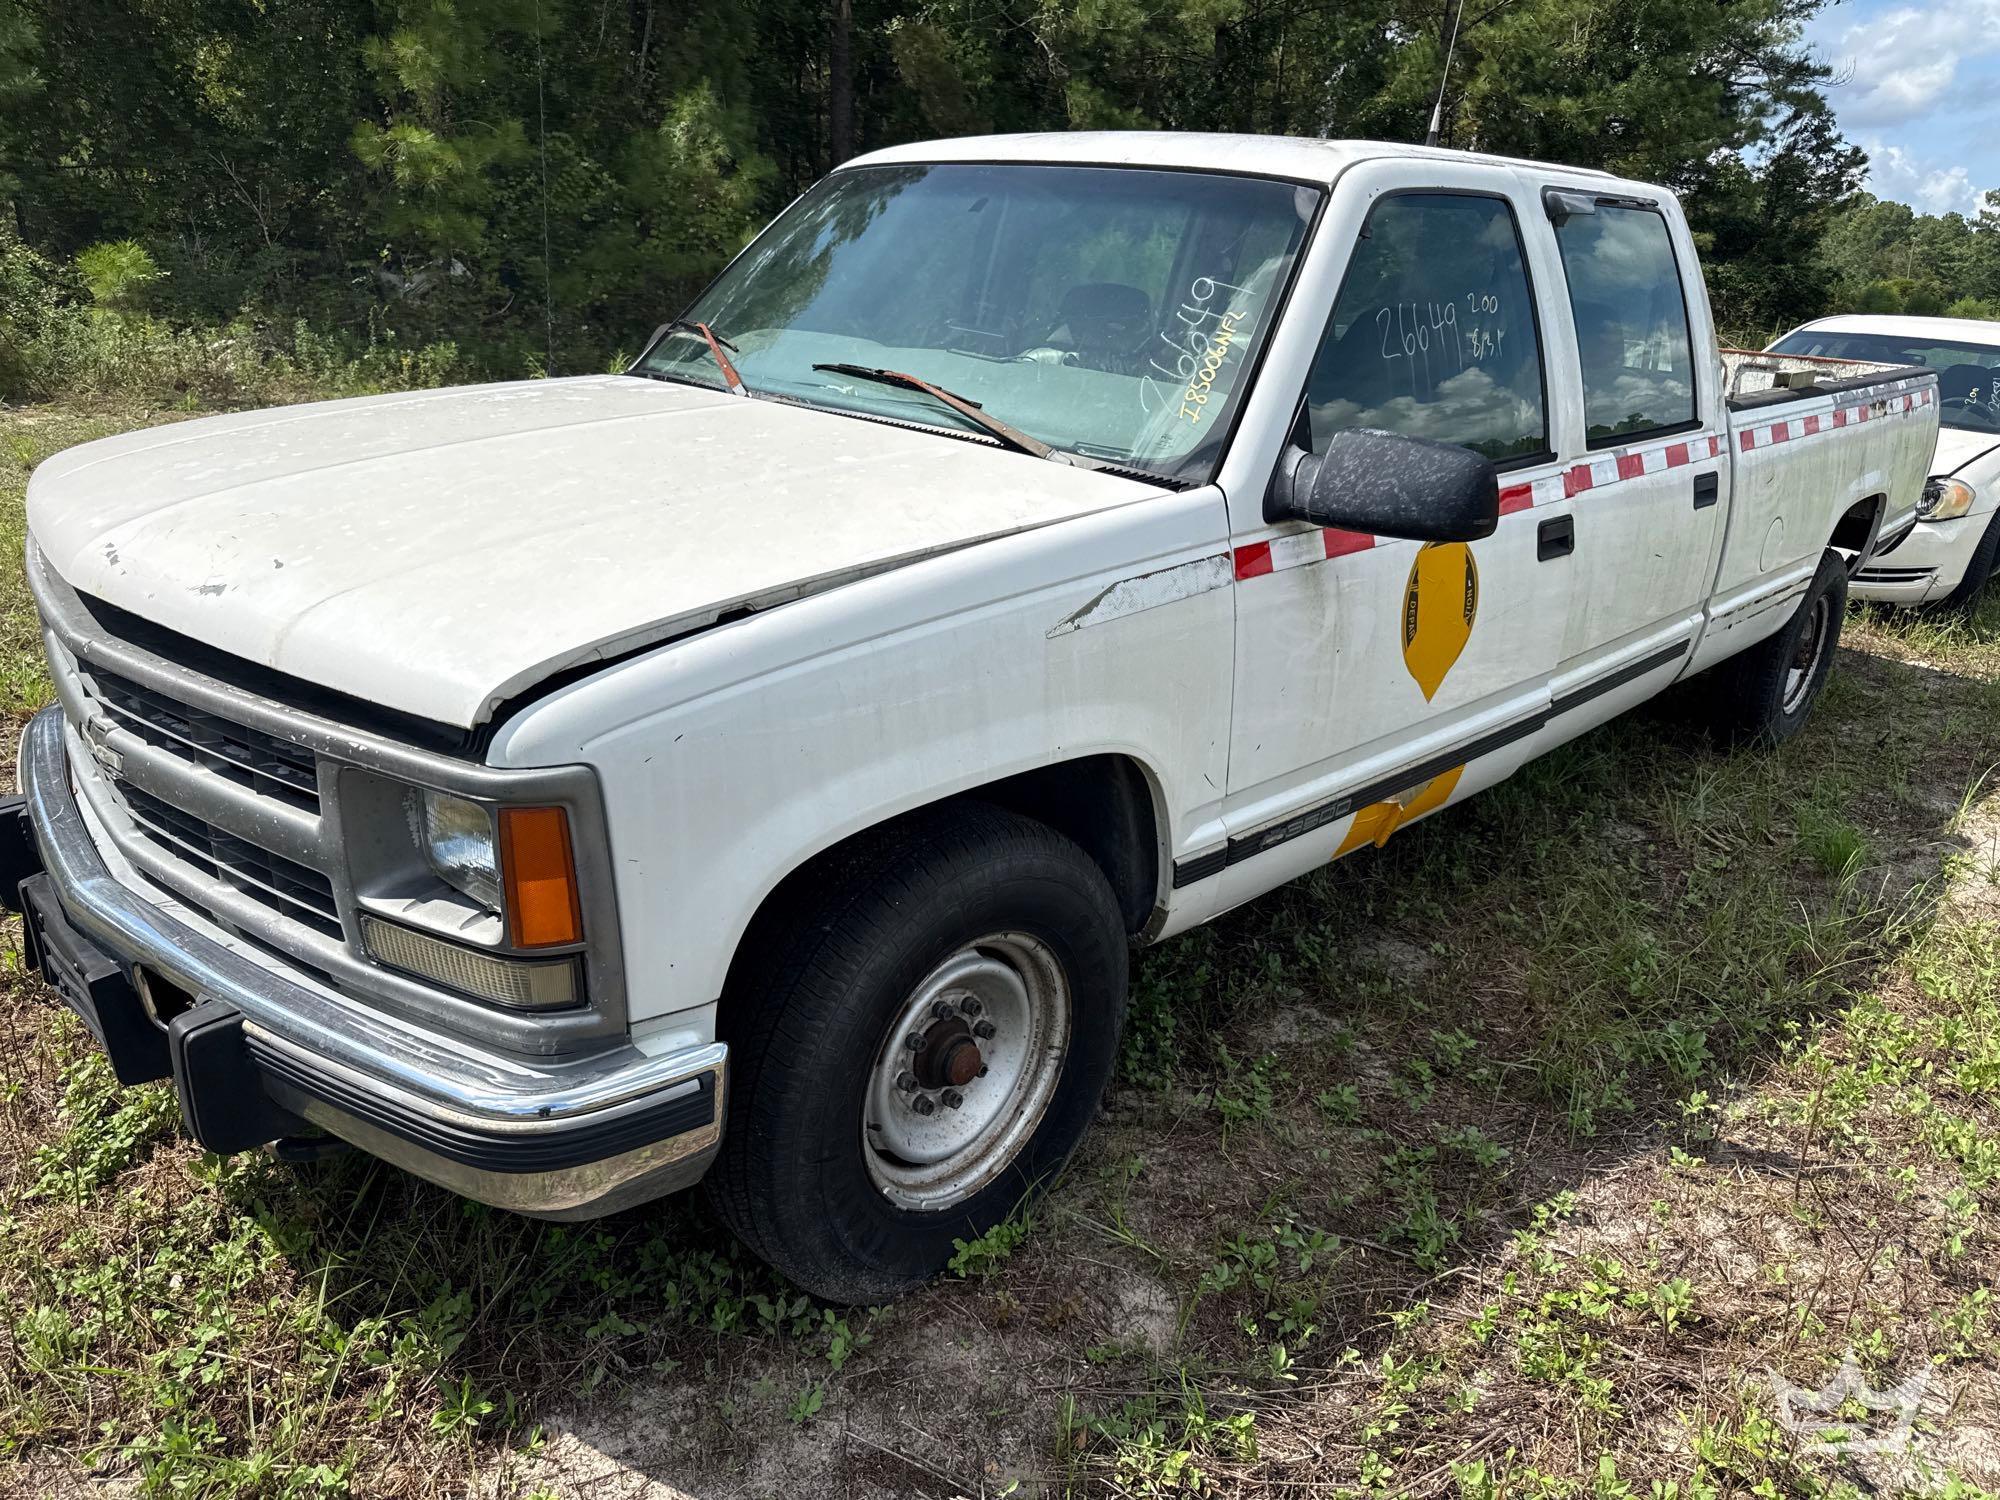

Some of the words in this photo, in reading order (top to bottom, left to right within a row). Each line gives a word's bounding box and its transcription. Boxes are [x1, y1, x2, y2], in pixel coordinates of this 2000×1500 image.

[1375, 301, 1463, 370] 26649
[1466, 292, 1499, 314] 200
[1140, 277, 1257, 417] 26649
